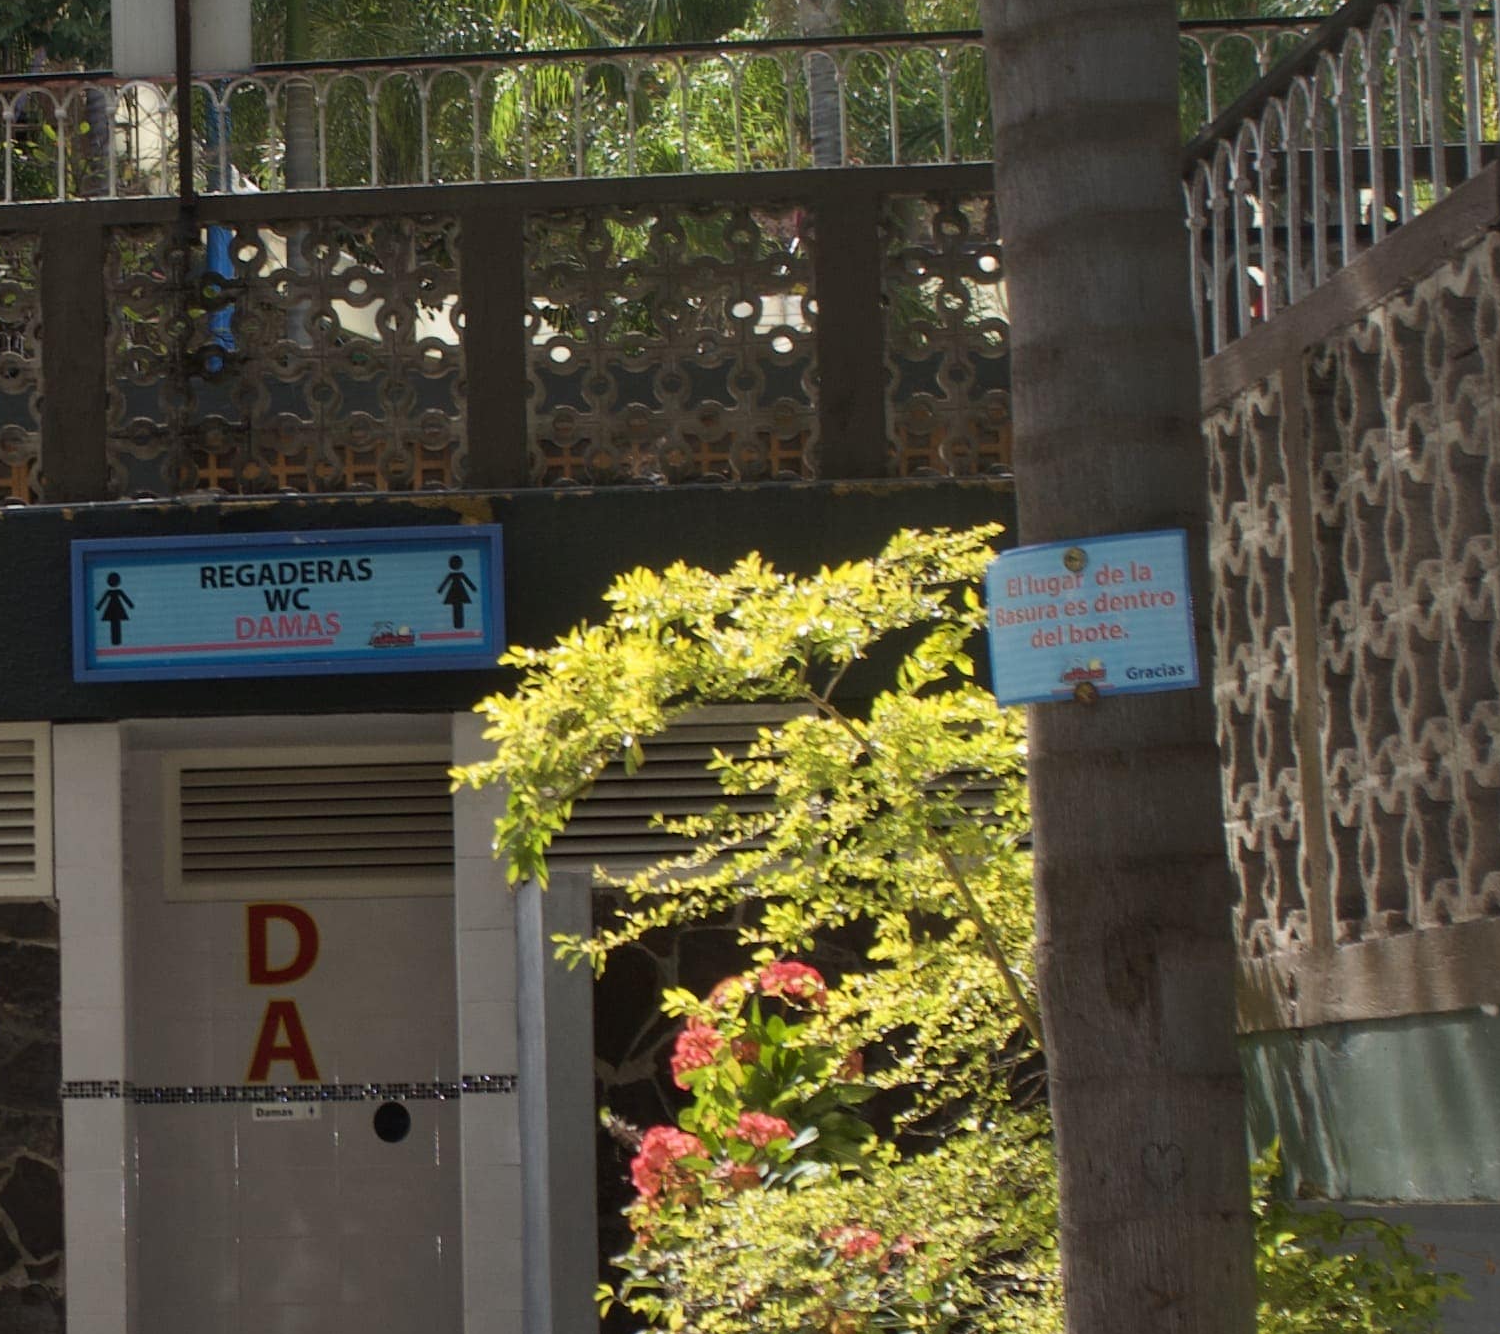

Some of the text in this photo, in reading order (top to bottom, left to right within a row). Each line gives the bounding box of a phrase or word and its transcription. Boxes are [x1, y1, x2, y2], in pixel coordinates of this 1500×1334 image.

[201, 557, 373, 589] REGADERAS
[1006, 561, 1152, 598] El lugar de la
[264, 587, 311, 612] WC
[995, 590, 1177, 627] Basura es dentro
[236, 612, 342, 641] DAMAS
[1031, 621, 1130, 649] del bote.
[1126, 663, 1185, 681] Gracias
[256, 1108, 294, 1118] Damas
